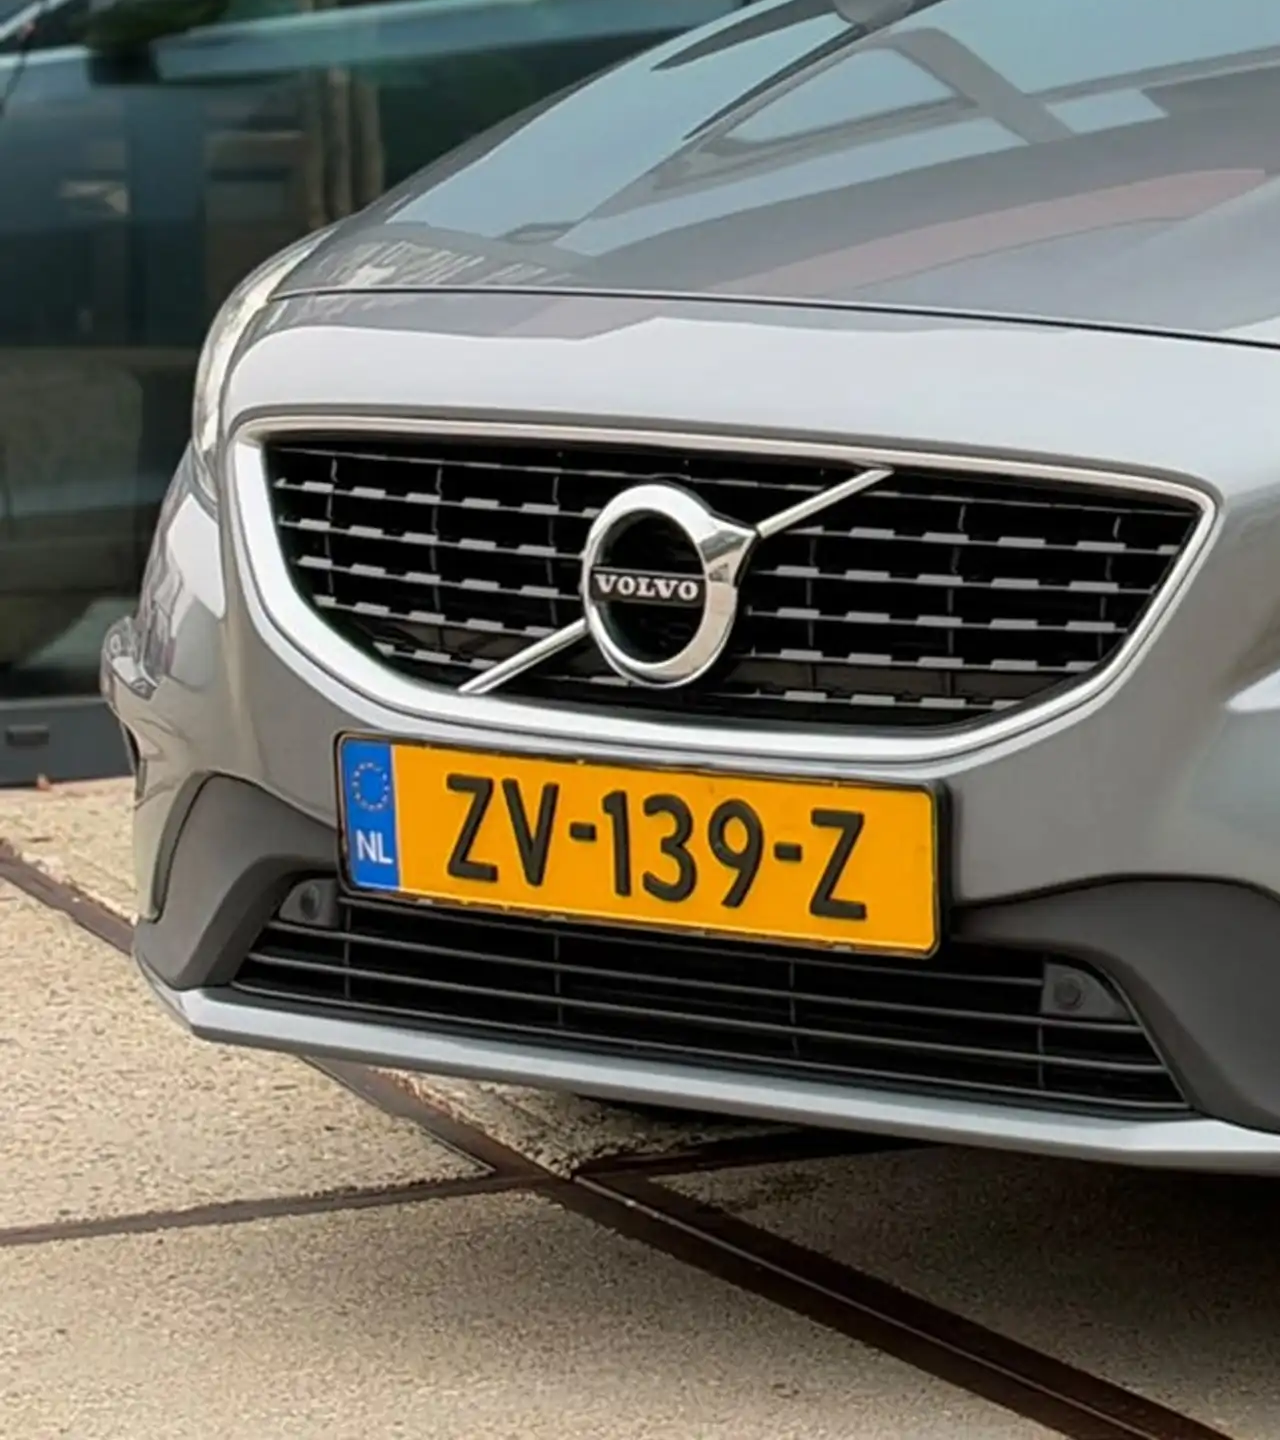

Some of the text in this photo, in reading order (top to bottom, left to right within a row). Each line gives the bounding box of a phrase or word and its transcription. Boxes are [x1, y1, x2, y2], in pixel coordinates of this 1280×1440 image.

[595, 573, 699, 601] VOLVO
[355, 829, 394, 865] NL
[445, 772, 868, 921] ZV-139-Z
